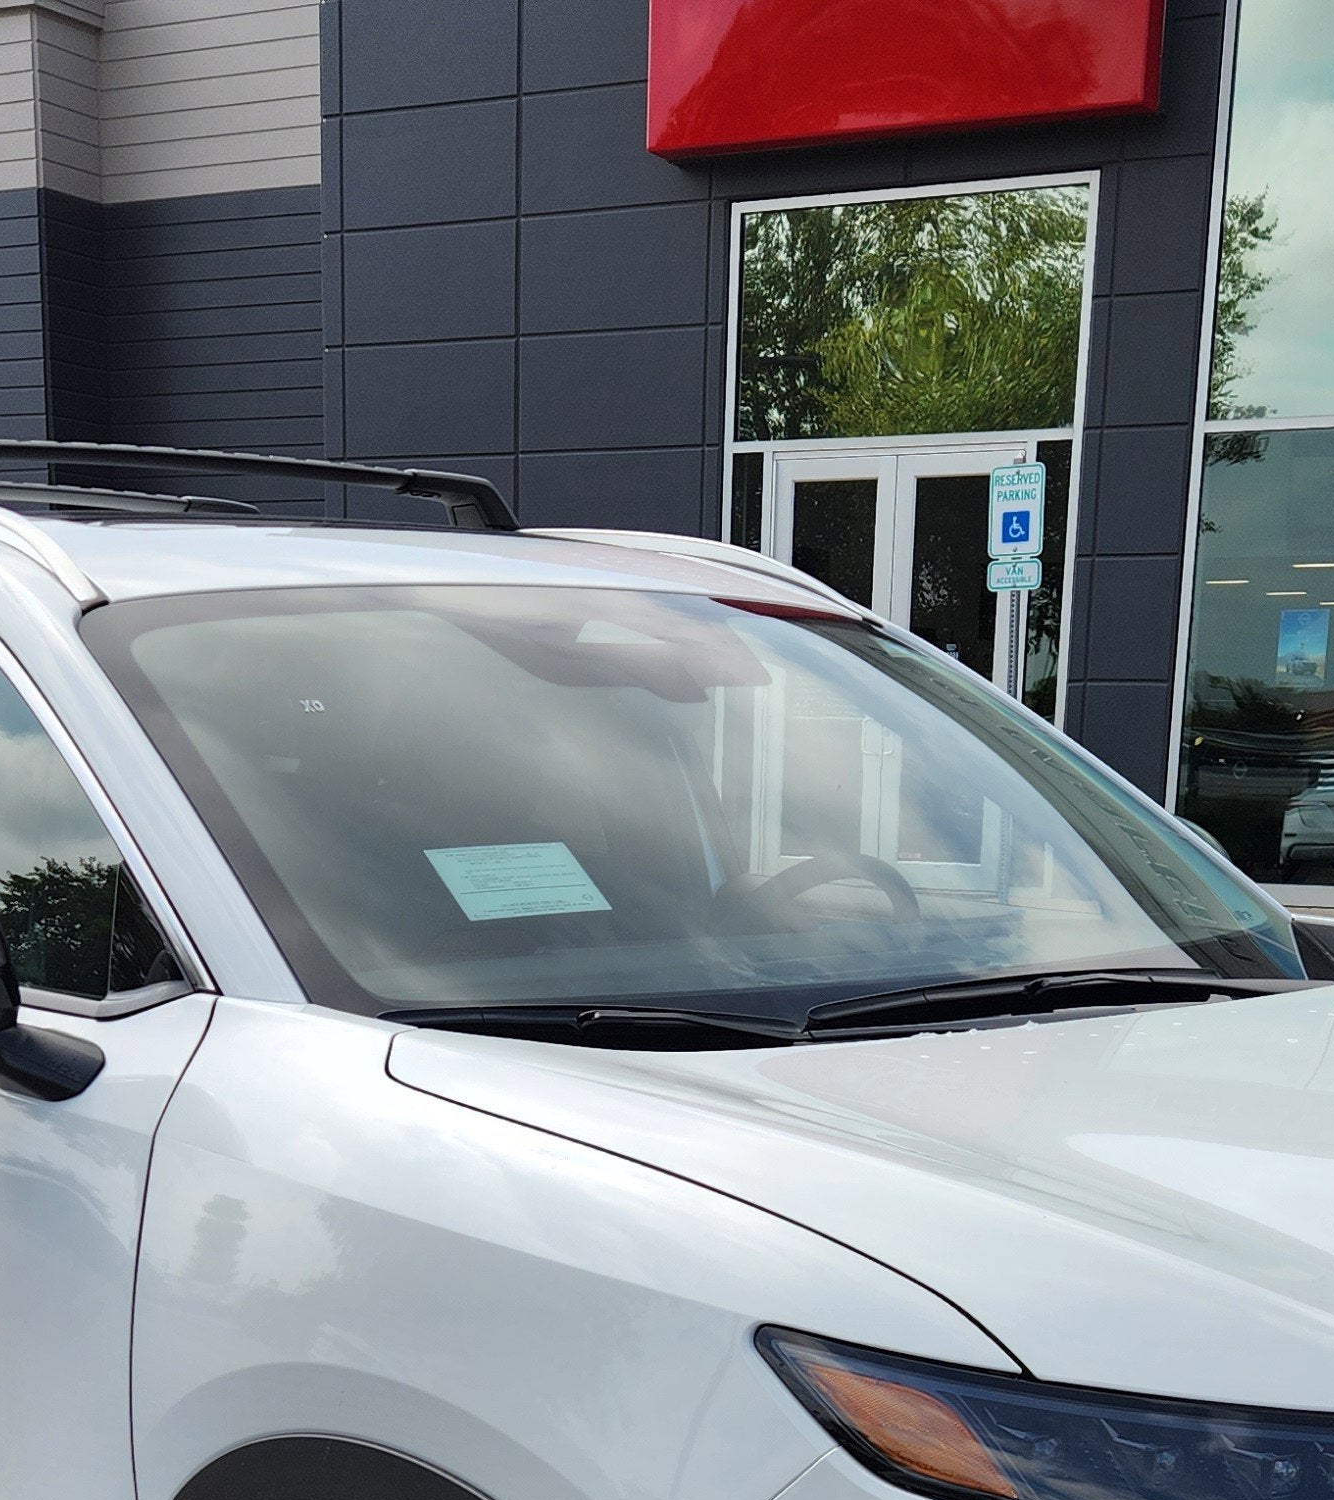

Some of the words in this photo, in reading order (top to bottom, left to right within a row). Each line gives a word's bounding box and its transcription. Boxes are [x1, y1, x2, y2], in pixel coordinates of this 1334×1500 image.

[994, 473, 1040, 487] RESERVED
[997, 488, 1036, 502] PARKING
[1005, 566, 1024, 576] VAN
